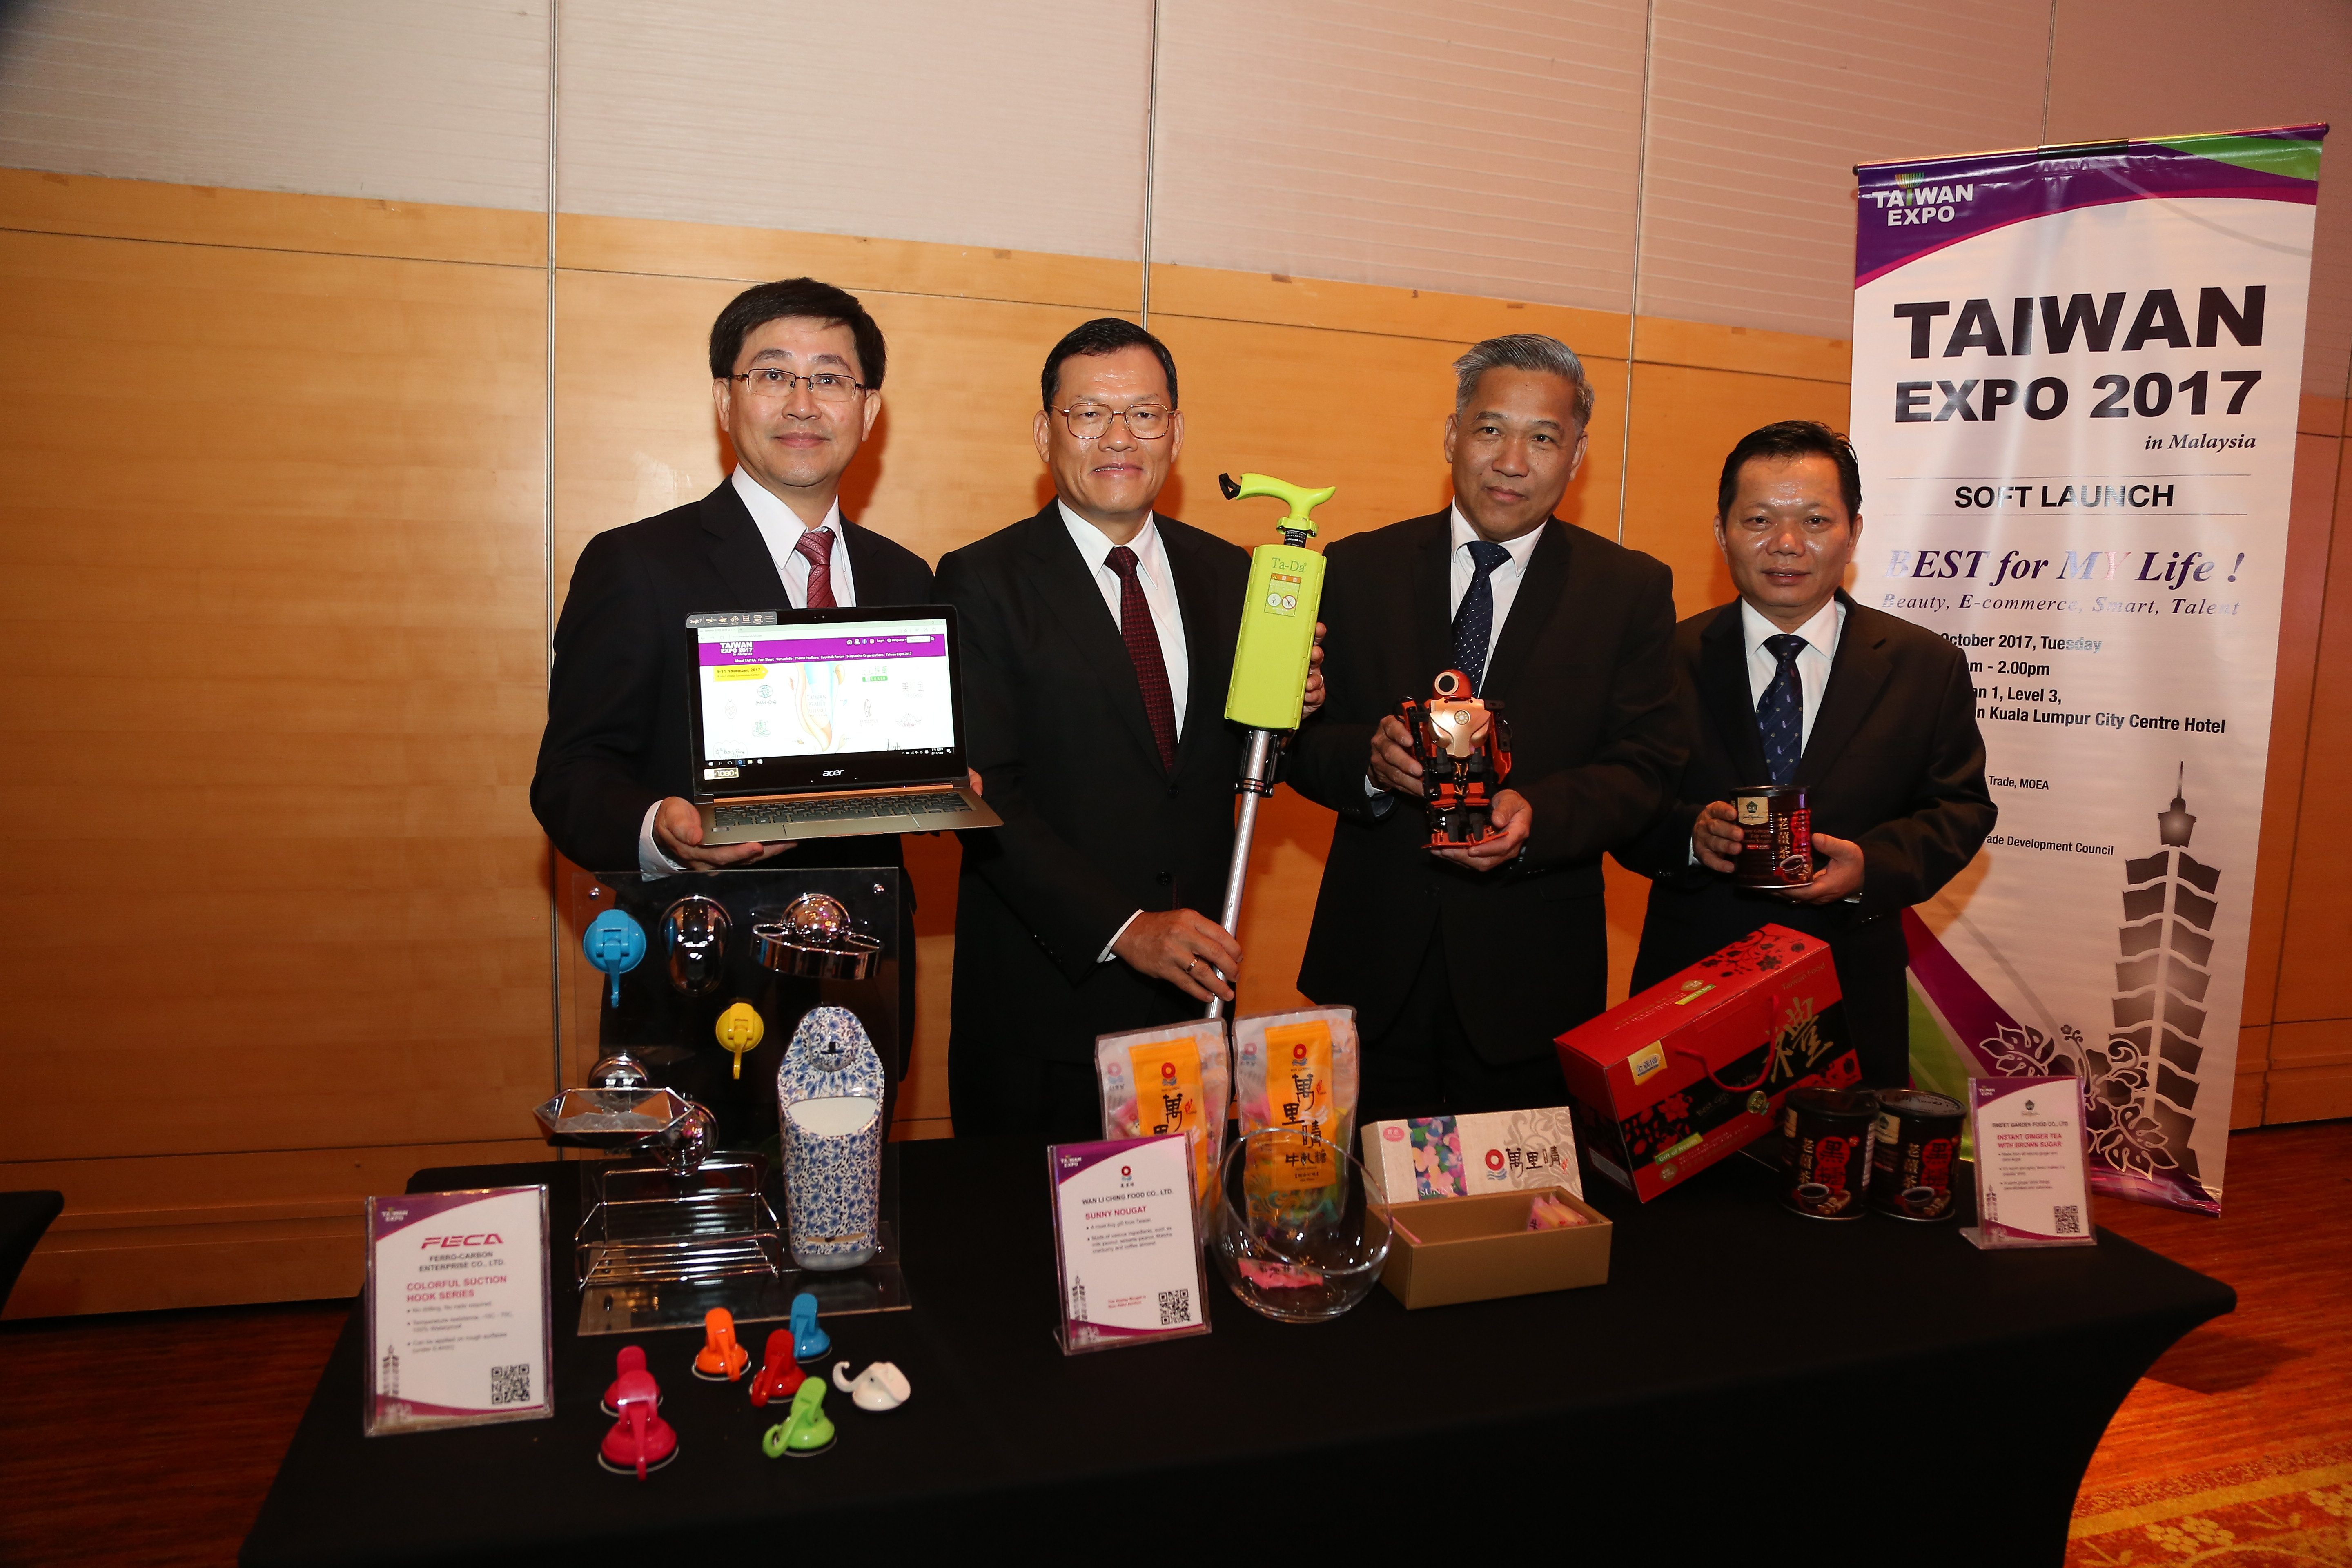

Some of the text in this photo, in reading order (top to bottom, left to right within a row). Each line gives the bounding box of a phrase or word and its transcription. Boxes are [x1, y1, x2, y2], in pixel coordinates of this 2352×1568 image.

[1872, 183, 1973, 208] TAIWAN
[1887, 205, 1955, 226] EXPO
[1894, 285, 2266, 359] TAIWAN
[1895, 371, 2262, 423] EXPO 2017
[2145, 433, 2256, 452] in Malaysia
[1954, 484, 2174, 508] SOFT LAUNCH
[1272, 557, 1305, 573] Ta-Da
[1885, 550, 2245, 590] BEST for MY Life !
[1882, 594, 2240, 617] Beauty, E-commerce, Smart, Talent
[1998, 635, 2036, 651] 2017,
[2041, 636, 2102, 654] Tuesday
[1998, 661, 2050, 677] 2.00pm
[1992, 686, 2003, 702] 1,
[2007, 687, 2044, 702] Level
[2049, 690, 2061, 705] 3,
[1989, 706, 2029, 722] Kuala
[2034, 709, 2091, 727] Lumpur
[2096, 712, 2125, 729] City
[2129, 714, 2180, 731] Centre
[2184, 717, 2225, 733] Hotel
[1989, 776, 2049, 790] Trade, MOEA
[2007, 836, 2114, 855] Development Council
[1659, 1154, 1670, 1162] Gift
[1085, 1206, 1147, 1220] SUNNY NOUGAT
[419, 1263, 468, 1272] ENTERPRISE
[407, 1276, 507, 1291] COLORFUL SUCTION
[407, 1289, 475, 1302] HOOK SERIES
